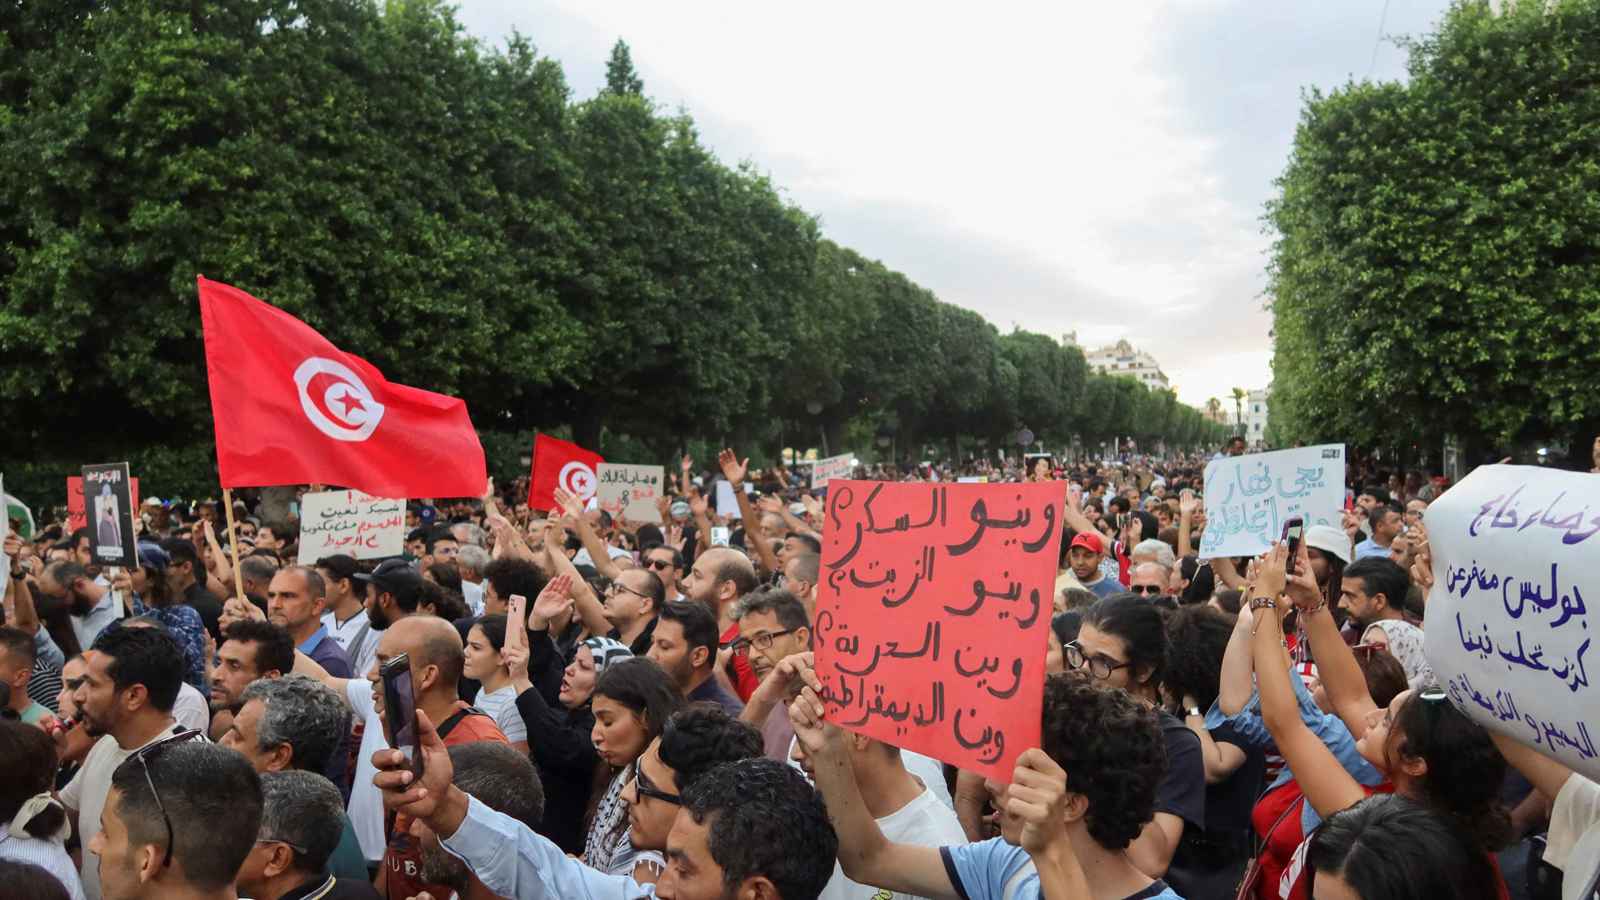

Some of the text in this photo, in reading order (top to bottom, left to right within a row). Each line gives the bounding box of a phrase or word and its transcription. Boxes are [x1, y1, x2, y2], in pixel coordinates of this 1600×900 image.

[945, 493, 1056, 556] وينو
[943, 571, 1041, 630] وينو
[1503, 562, 1588, 630] بوليس
[953, 646, 1023, 700] وين
[953, 707, 1006, 764] وين
